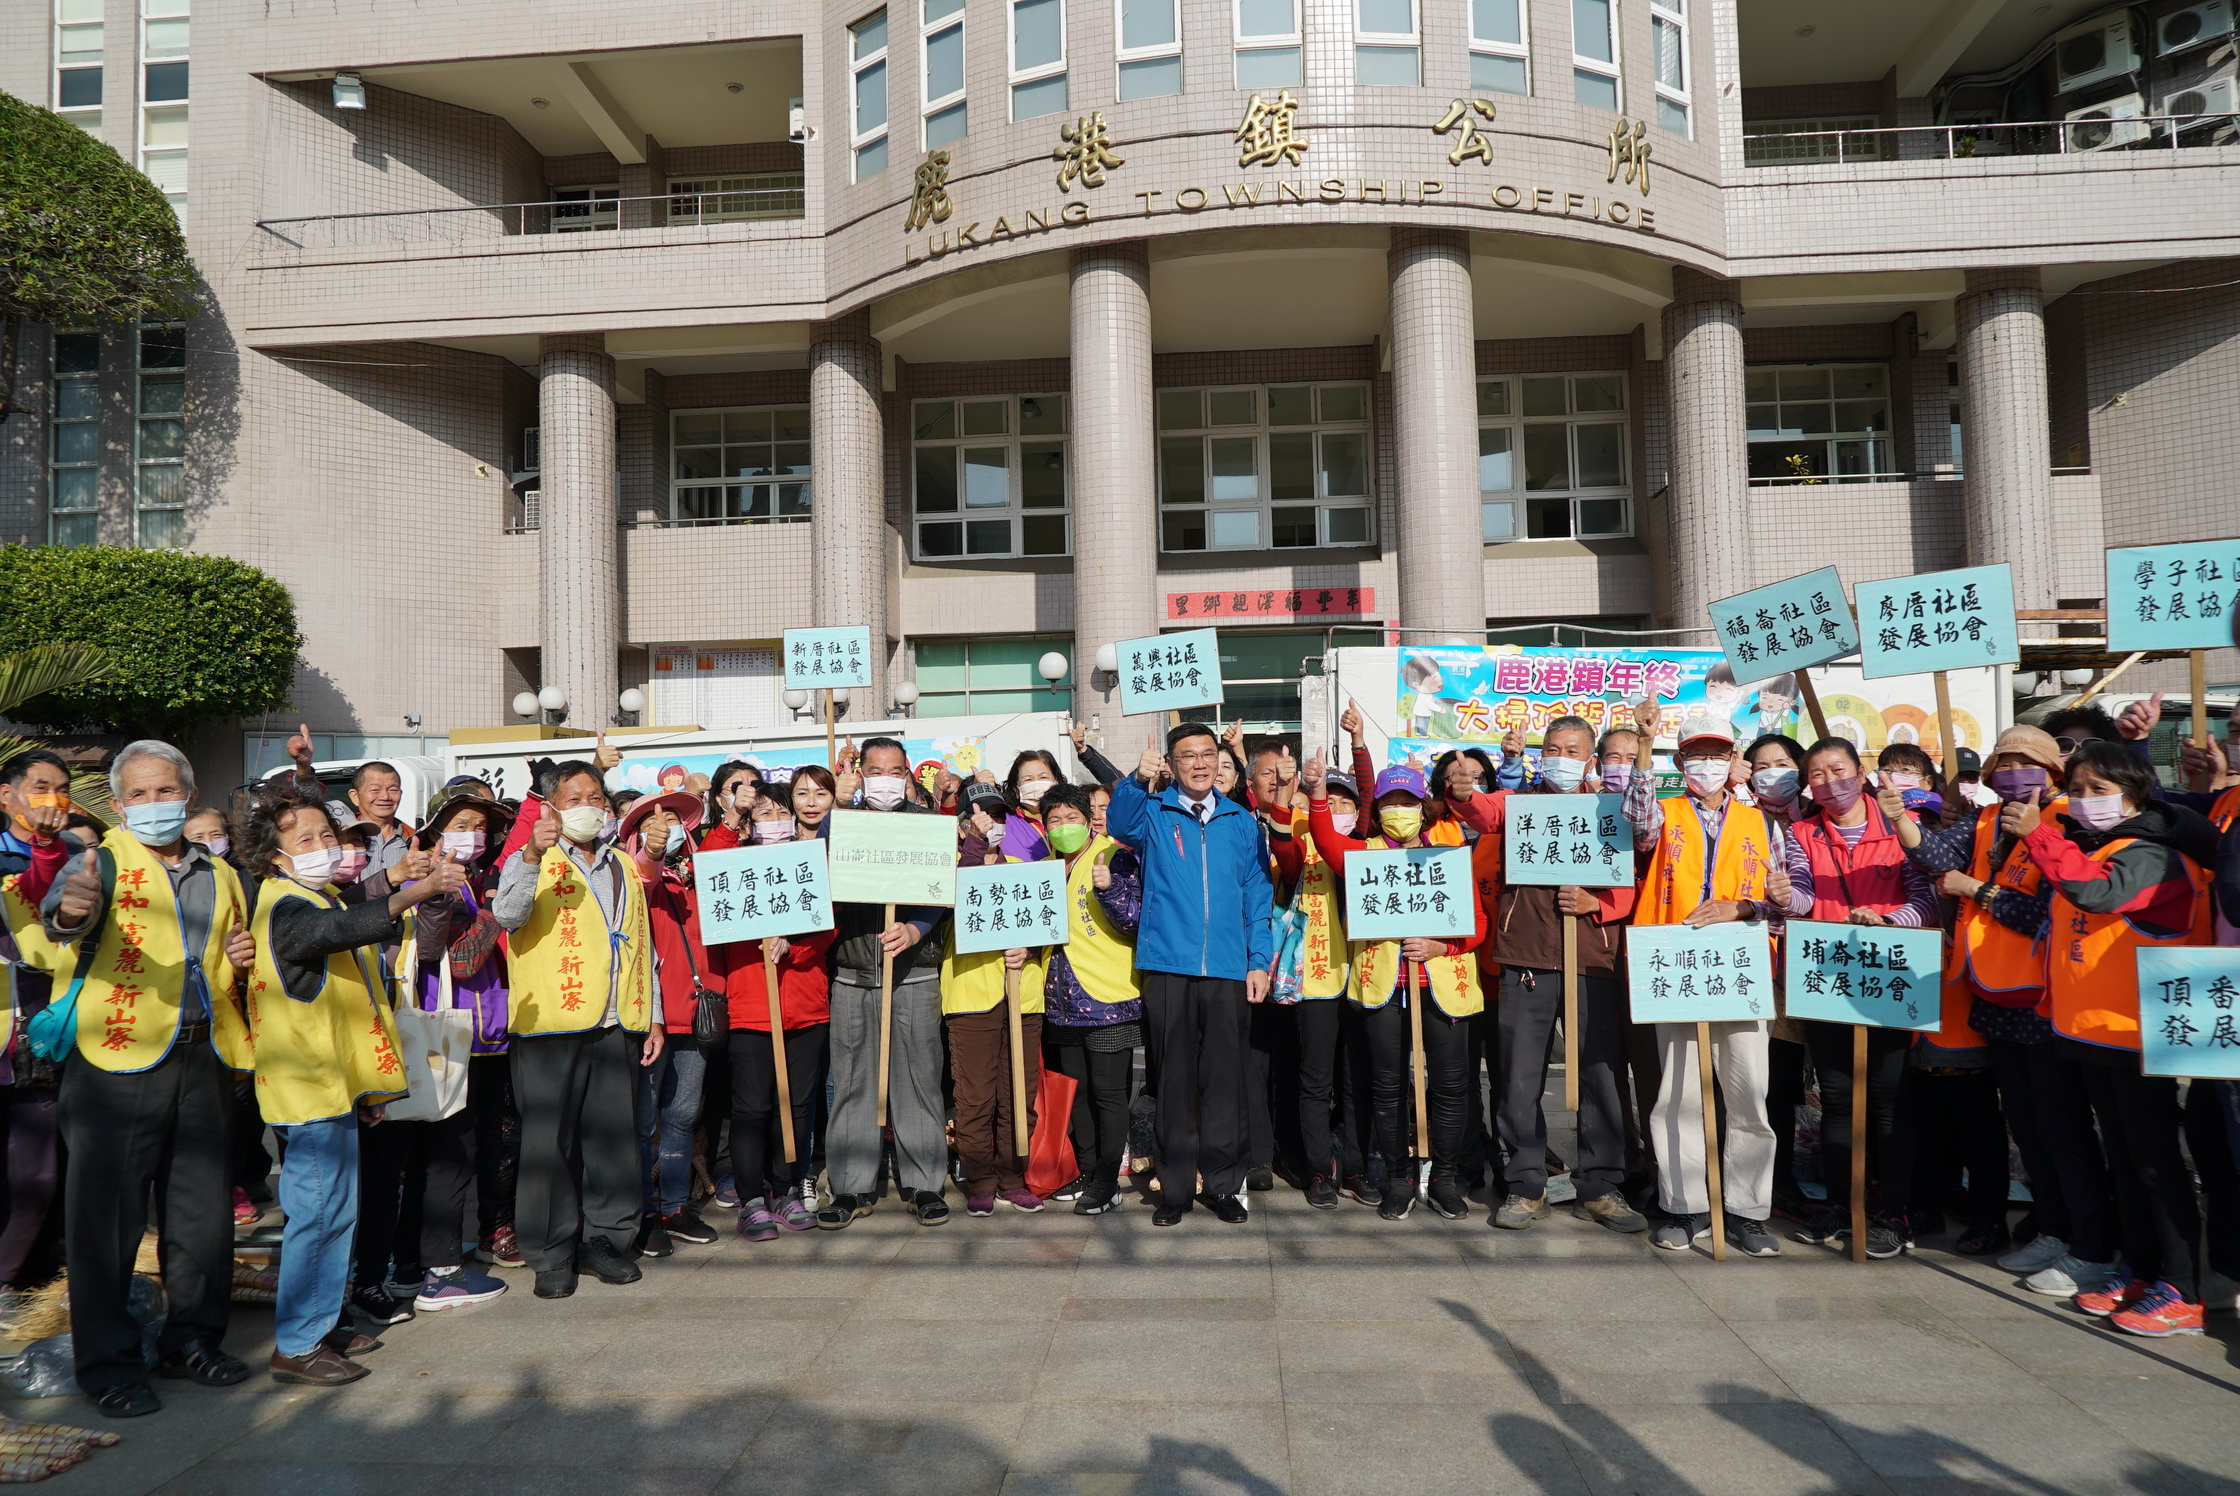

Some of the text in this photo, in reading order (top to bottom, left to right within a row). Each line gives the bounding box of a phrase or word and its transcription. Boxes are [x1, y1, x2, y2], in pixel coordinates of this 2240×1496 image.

[904, 89, 1654, 232] 鹿港鎮公所
[905, 177, 1657, 264] LUKANG TOWNSHIP OFFICE
[1726, 592, 1832, 638] 福崙社區
[1879, 583, 1982, 622] 廖厝社區
[2135, 588, 2240, 622] 發展協
[792, 640, 860, 658] 新厝社區
[1737, 618, 1841, 664] 發展協會
[1879, 616, 1987, 652] 發展協會
[793, 658, 863, 676] 發展協會
[1132, 642, 1198, 671] 萬興社區
[1131, 667, 1202, 695] 發展協會
[1496, 657, 1680, 698] 鹿港鎮年終
[1837, 701, 1849, 709] 02
[1516, 814, 1618, 838] 洋厝社區
[836, 848, 951, 867] 山崙社區發展協會
[1516, 841, 1620, 865] 發展協會
[710, 862, 814, 893] 頂厝社區
[1360, 861, 1447, 887] 山寮社區
[712, 888, 818, 922] 發展協會
[966, 880, 1055, 907] 南勢社區
[1361, 890, 1451, 916] 發展協會
[965, 904, 1057, 934] 發展協會
[1649, 947, 1751, 972] 永順社區
[1802, 938, 1909, 971] 埔崙社區
[1651, 973, 1755, 999] 發展協會
[1802, 970, 1912, 1002] 發展協會
[2159, 1014, 2240, 1049] 發展
